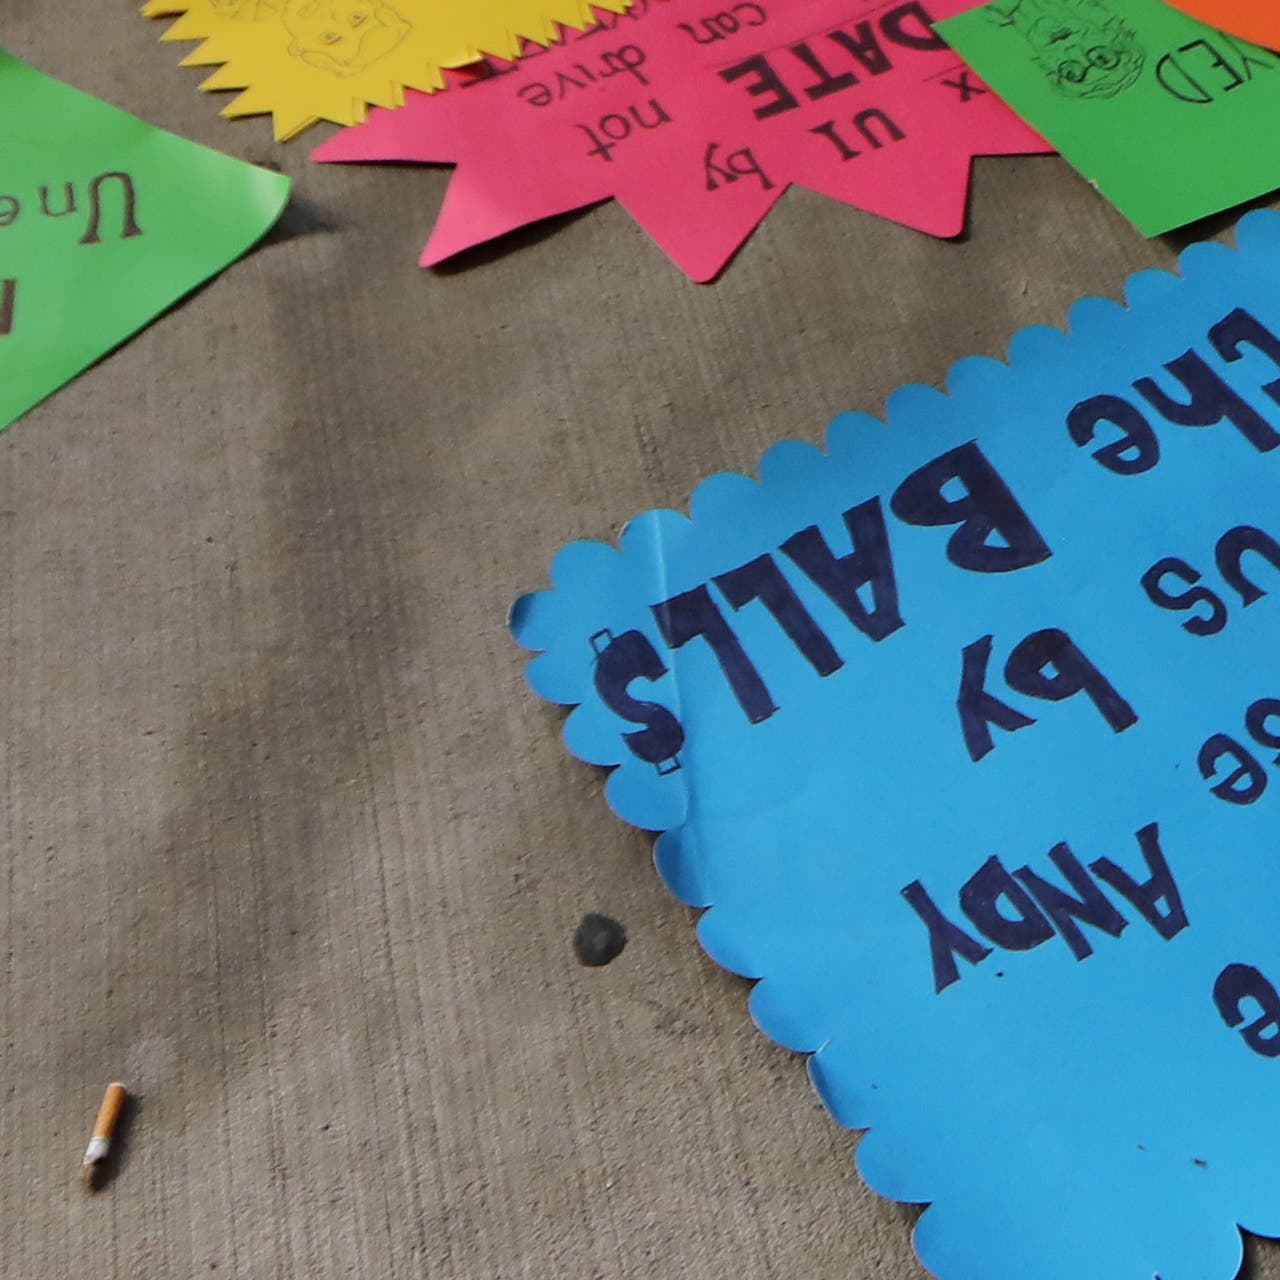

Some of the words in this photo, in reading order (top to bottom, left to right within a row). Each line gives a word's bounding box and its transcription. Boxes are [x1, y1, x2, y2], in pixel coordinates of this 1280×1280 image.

[676, 1, 767, 48] can
[515, 43, 647, 110] drive
[716, 0, 952, 121] DATE
[571, 98, 672, 163] not
[807, 107, 907, 161] UI
[704, 142, 775, 192] by
[958, 628, 1138, 763] by
[899, 823, 1191, 995] ANDY
